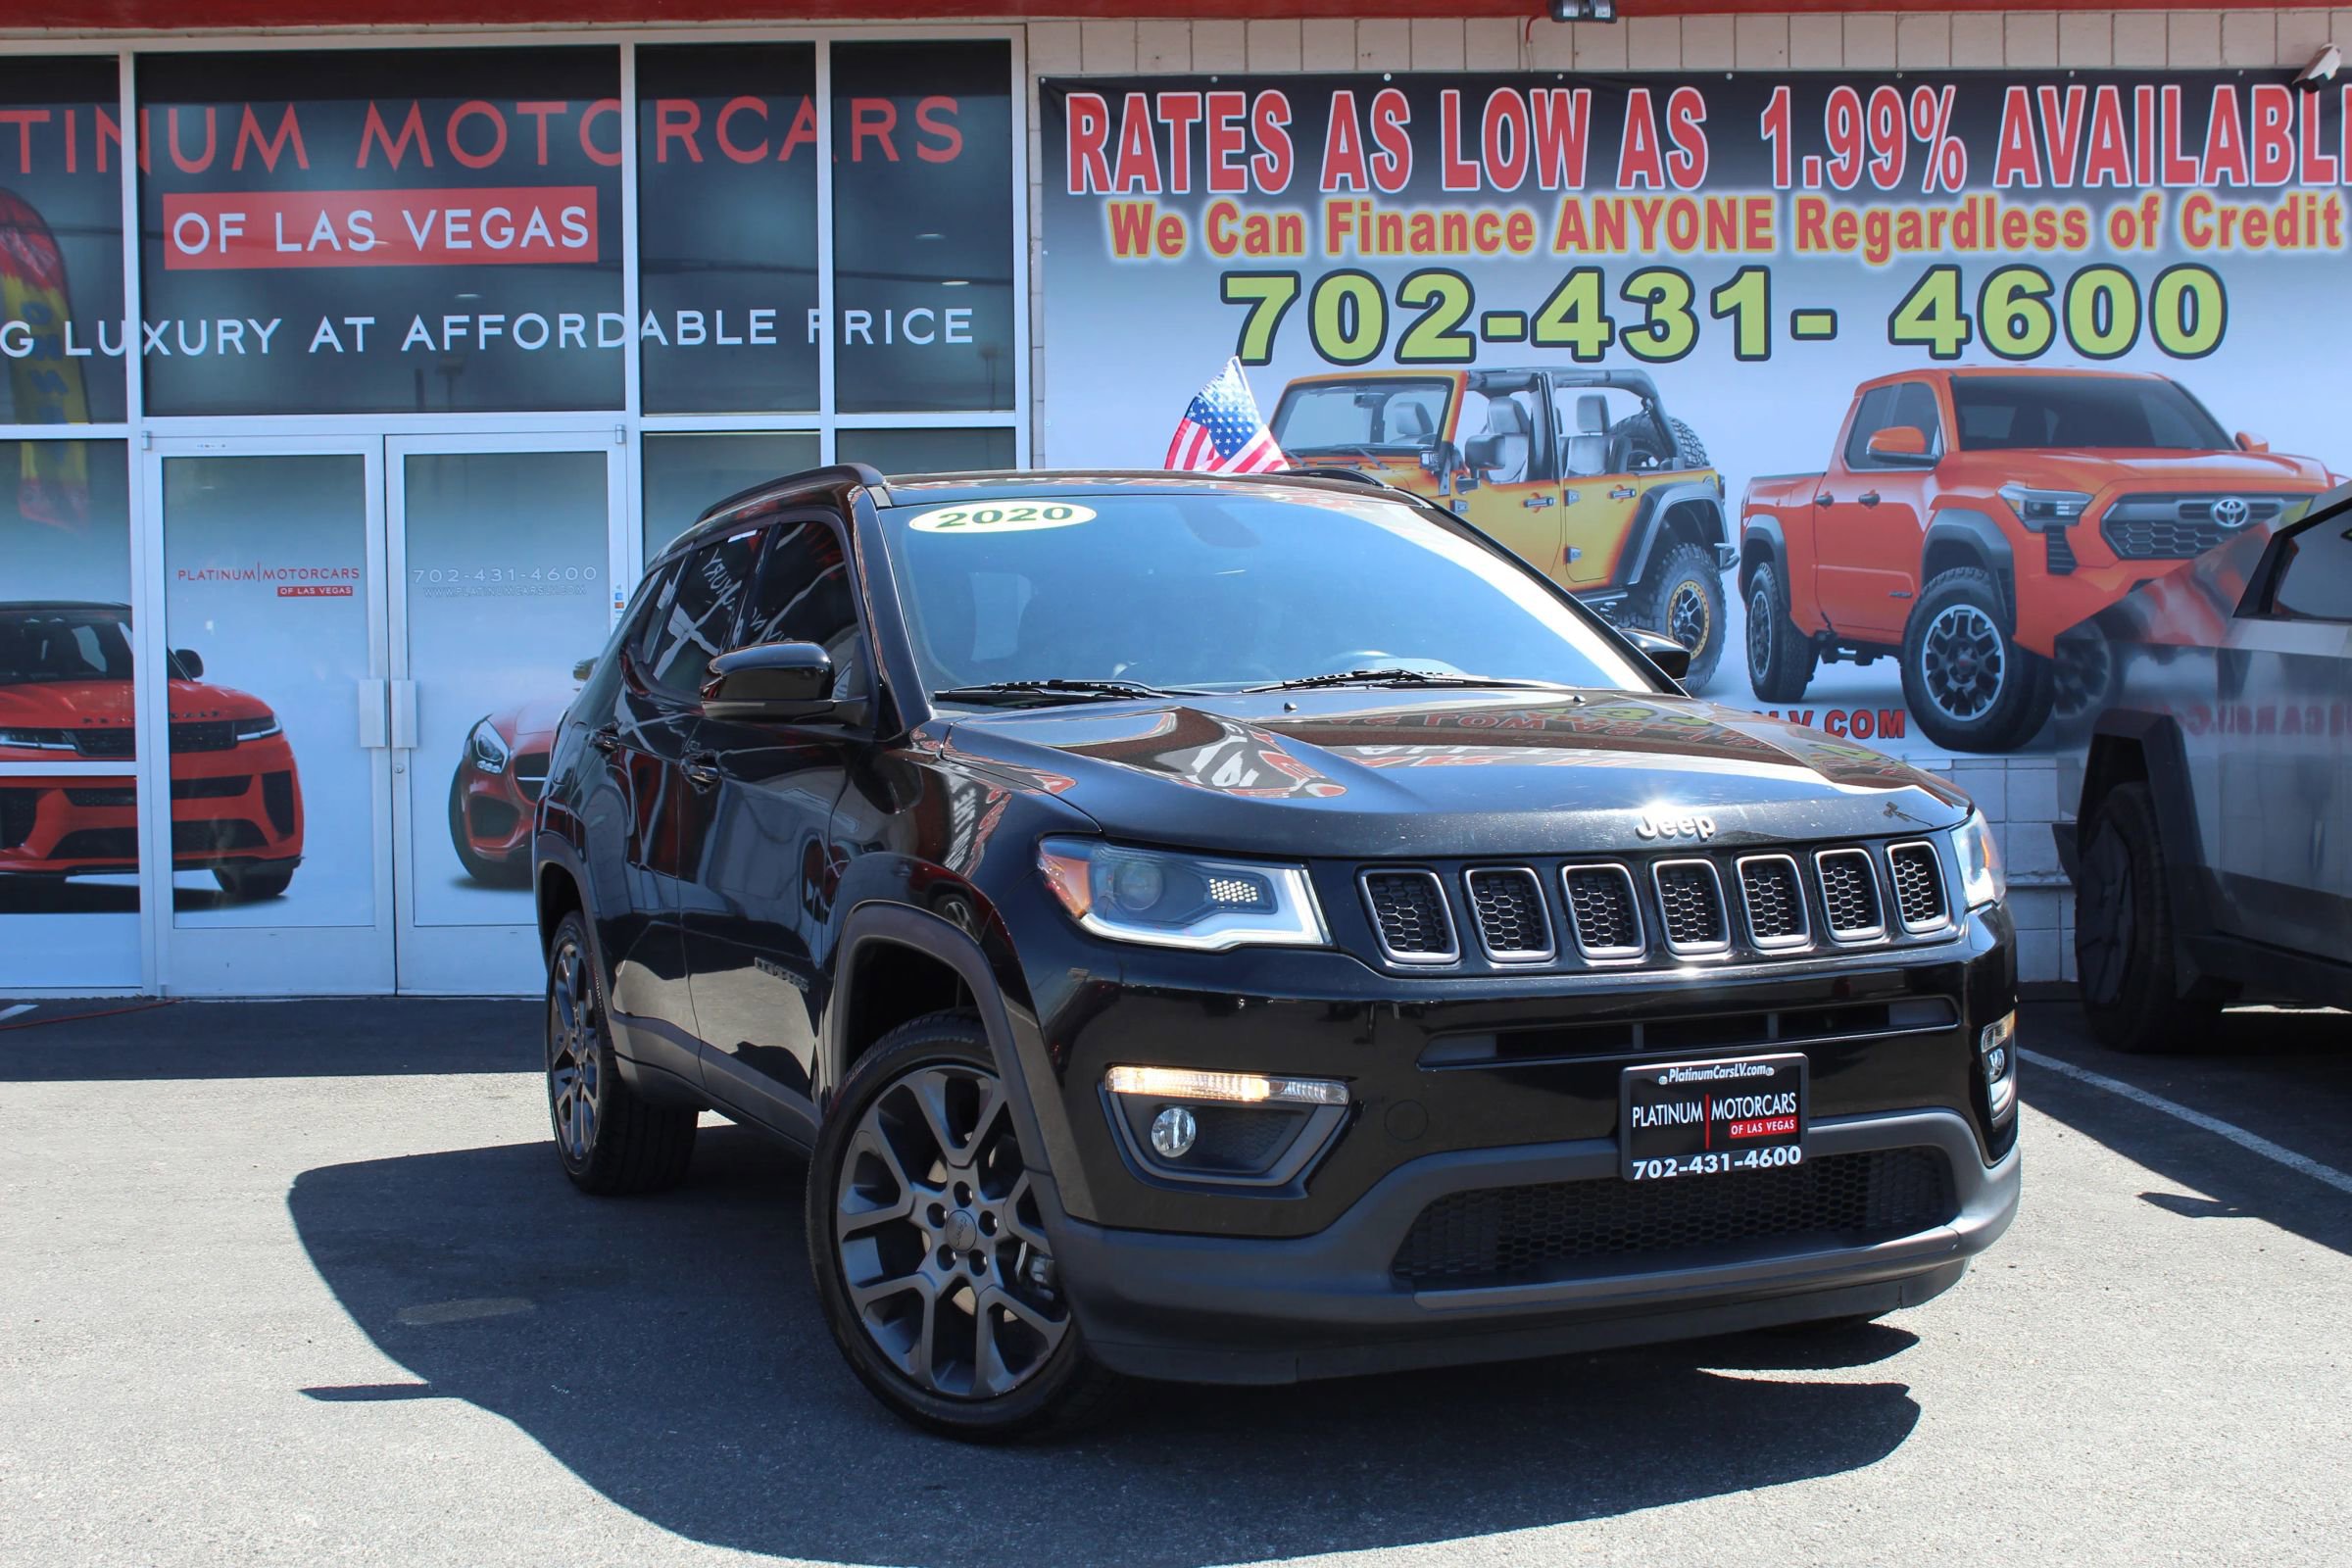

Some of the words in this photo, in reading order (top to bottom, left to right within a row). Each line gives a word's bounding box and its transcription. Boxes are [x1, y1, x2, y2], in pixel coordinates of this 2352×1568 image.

[356, 95, 963, 170] MOTORCARS
[1065, 89, 1294, 195] RATES
[1319, 87, 1413, 193] AS
[1440, 86, 1592, 191] LOW
[1615, 86, 1709, 191] AS
[1760, 84, 1968, 194] 1.99%
[1992, 83, 2352, 188] AVAILABL
[173, 212, 246, 255] OF
[275, 209, 375, 252] LAS
[402, 206, 590, 249] VEGAS
[1107, 200, 1188, 258] We
[1205, 198, 1304, 257] Can
[1324, 198, 1537, 256] Finance
[1553, 194, 1776, 254] ANYONE
[1795, 194, 2089, 265] Regardless
[2108, 194, 2162, 252] of
[2180, 192, 2343, 251] Credit
[1888, 262, 2228, 361] 4600
[65, 317, 282, 357] LUXURY
[308, 315, 375, 354] AT
[400, 308, 777, 352] AFFORDABLE
[936, 506, 1073, 529] 2020
[178, 569, 255, 581] PLATINUM
[263, 567, 360, 580] MOTORCARS
[319, 586, 352, 595] VEGAS
[413, 566, 597, 583] 702-431-4600
[1634, 812, 1716, 843] Jeep
[1669, 1063, 1766, 1084] PlatinumCarsLV.com
[1633, 1101, 1703, 1127] PLATINUM
[1711, 1092, 1796, 1121] MOTORCARS
[1731, 1124, 1744, 1135] OF
[1747, 1122, 1763, 1134] LAS
[1767, 1119, 1794, 1132] VEGAS
[1632, 1146, 1801, 1180] 702-431-4600
